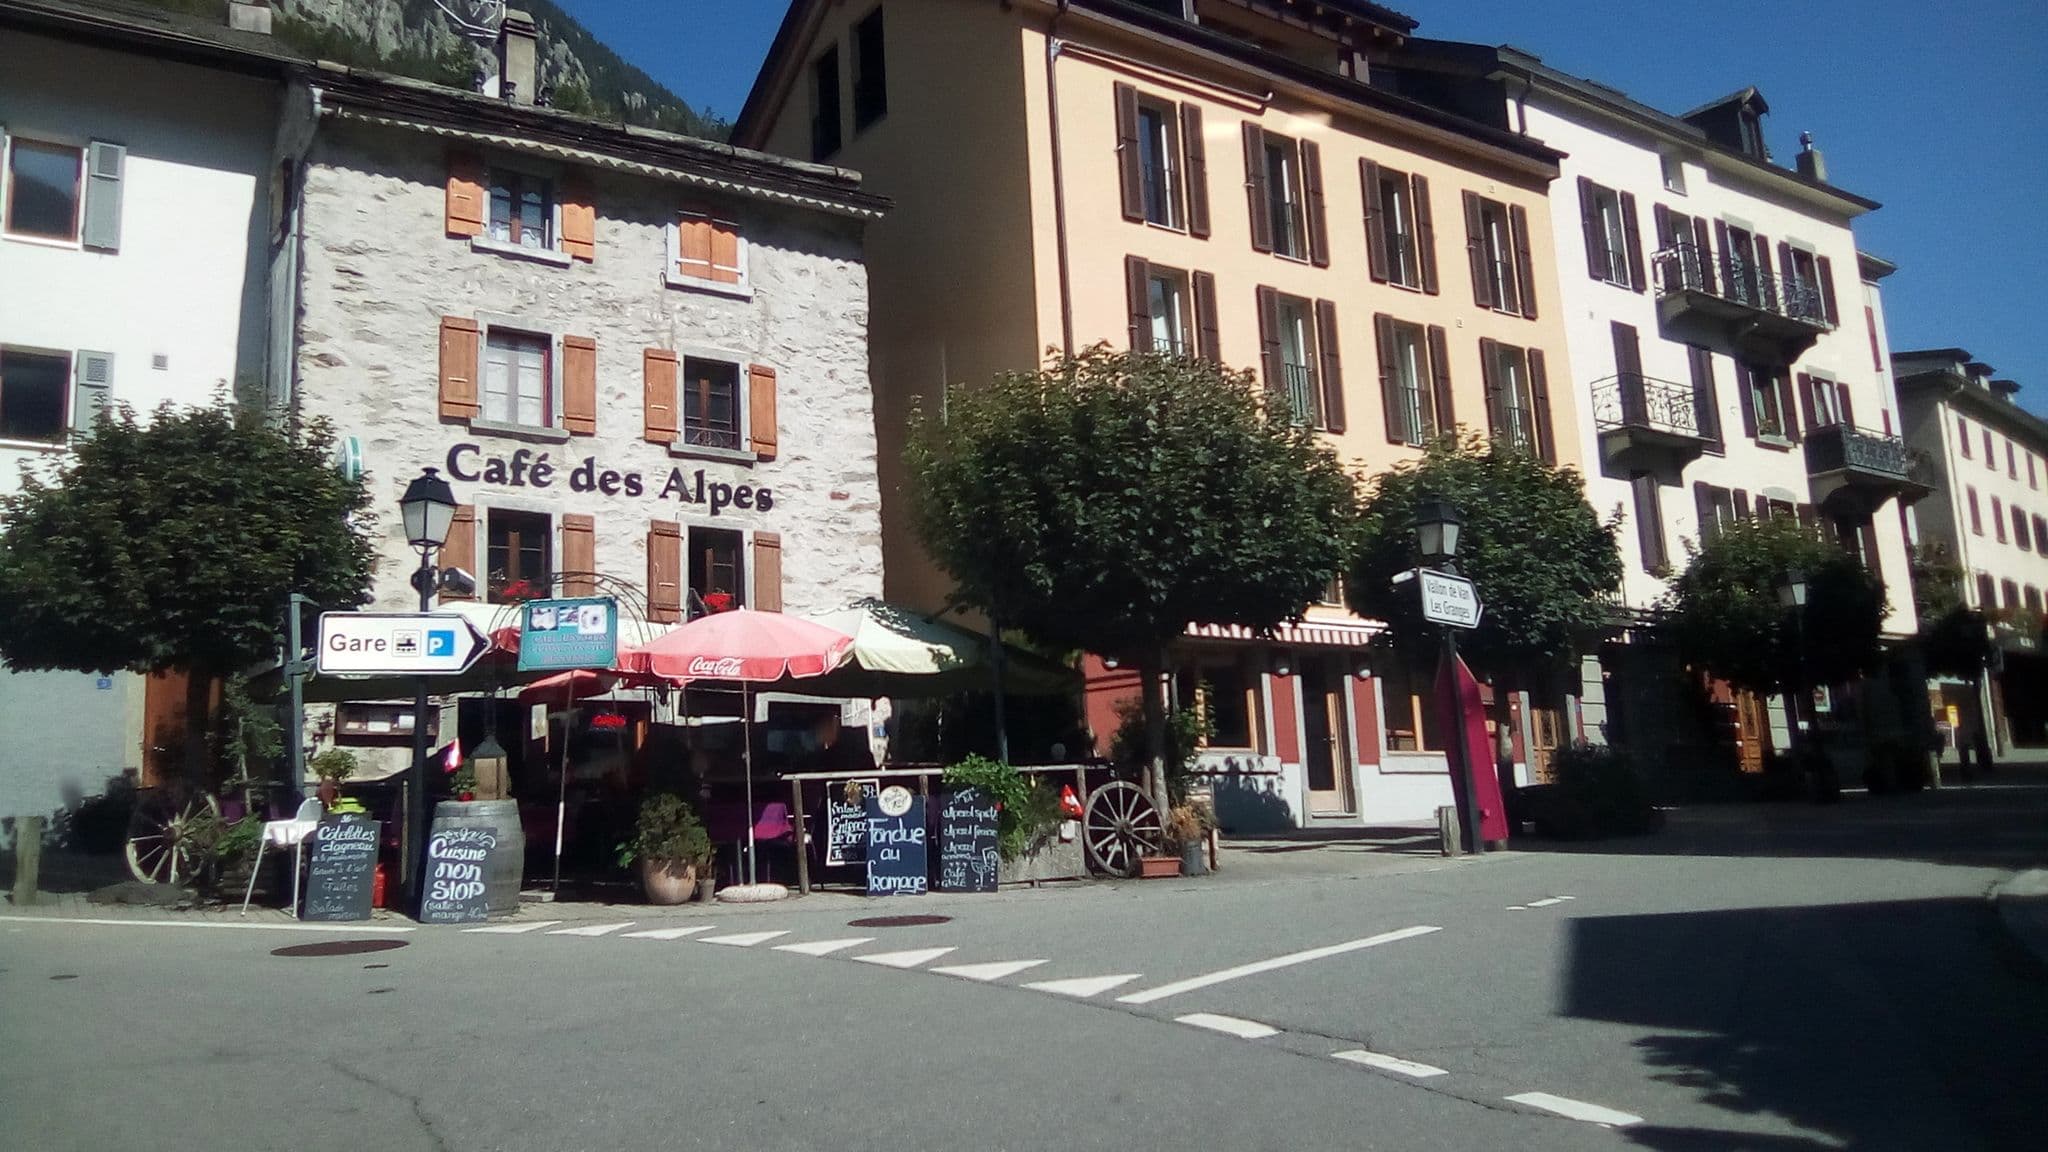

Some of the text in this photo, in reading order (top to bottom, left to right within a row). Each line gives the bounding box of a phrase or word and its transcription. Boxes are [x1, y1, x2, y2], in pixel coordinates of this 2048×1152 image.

[446, 443, 775, 516] Café des Alpes
[1425, 579, 1470, 600] Vallon de Van
[1430, 598, 1470, 622] Les Granges
[329, 633, 443, 654] Gare P
[867, 817, 926, 847] Fondue
[430, 837, 487, 861] Cuisine
[880, 848, 900, 861] au
[435, 862, 482, 882] non
[867, 859, 926, 894] fromage
